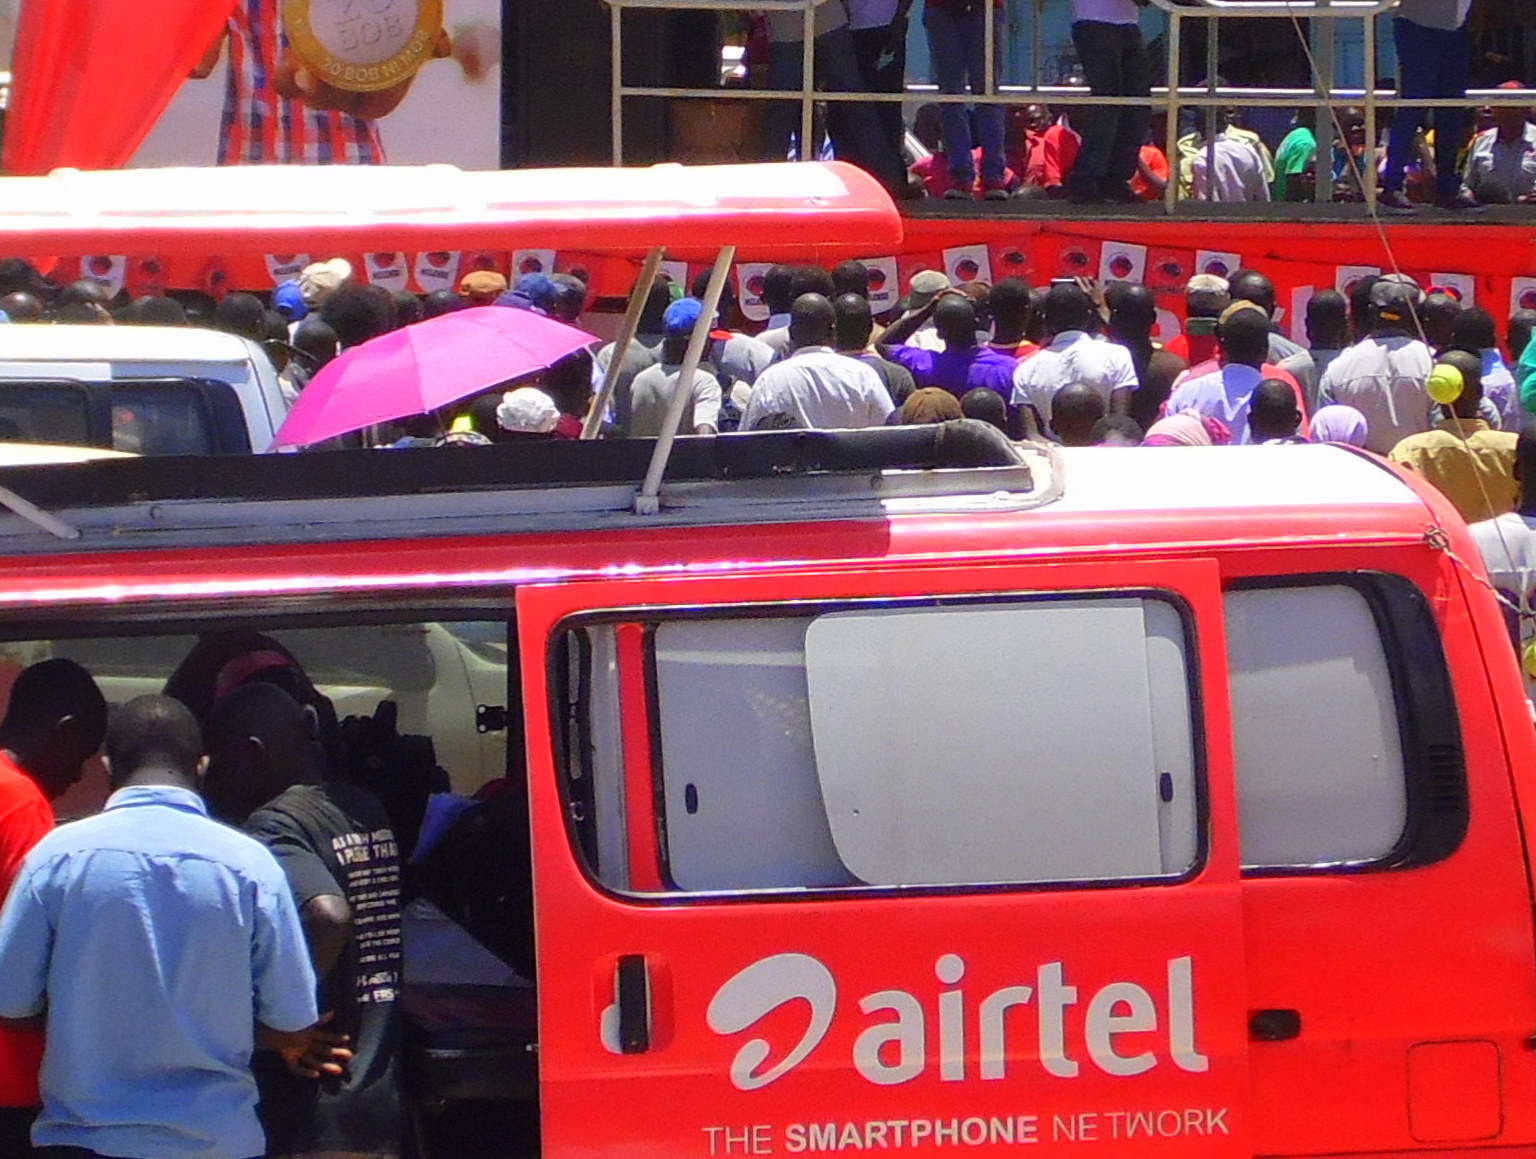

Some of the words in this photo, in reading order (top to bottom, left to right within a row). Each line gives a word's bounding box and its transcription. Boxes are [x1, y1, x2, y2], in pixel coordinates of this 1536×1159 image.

[345, 66, 380, 82] BOB
[852, 952, 1208, 1086] airtel
[702, 1124, 773, 1156] THE
[784, 1114, 1040, 1153] SMARTPHONE
[1052, 1107, 1230, 1143] NETWORK
